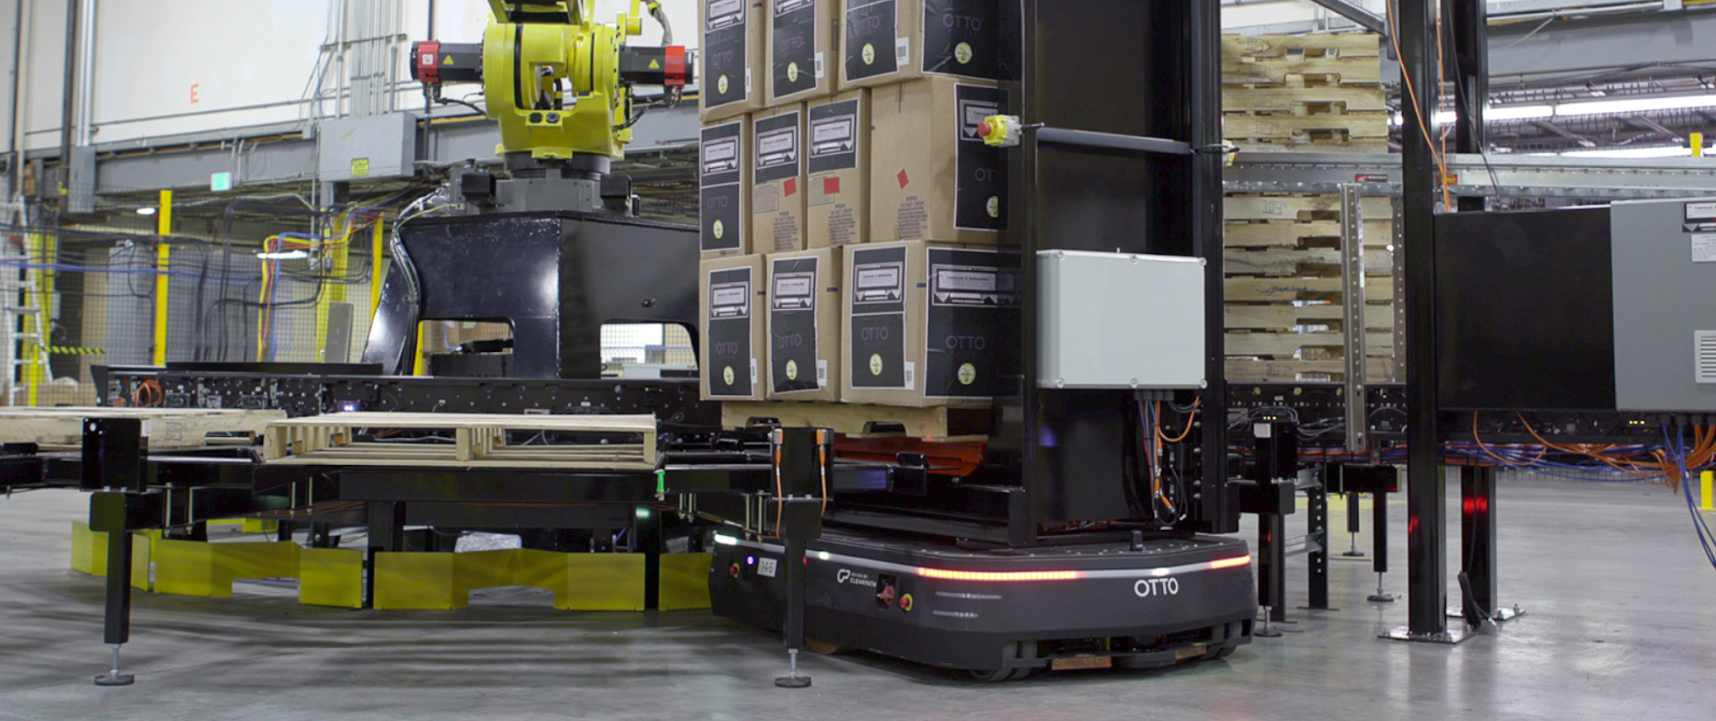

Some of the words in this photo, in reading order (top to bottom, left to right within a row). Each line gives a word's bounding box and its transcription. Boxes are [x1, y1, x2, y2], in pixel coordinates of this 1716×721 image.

[855, 15, 880, 34] OTTO
[942, 13, 982, 31] OTTO
[190, 83, 200, 104] E
[707, 195, 728, 210] OTTO
[778, 333, 802, 349] OTTO
[861, 326, 889, 341] OTTO
[715, 341, 739, 355] OTTO
[945, 334, 986, 351] OTTO
[760, 560, 774, 574] 146
[850, 577, 877, 588] CLEARPATH
[1134, 577, 1179, 598] OTTO
